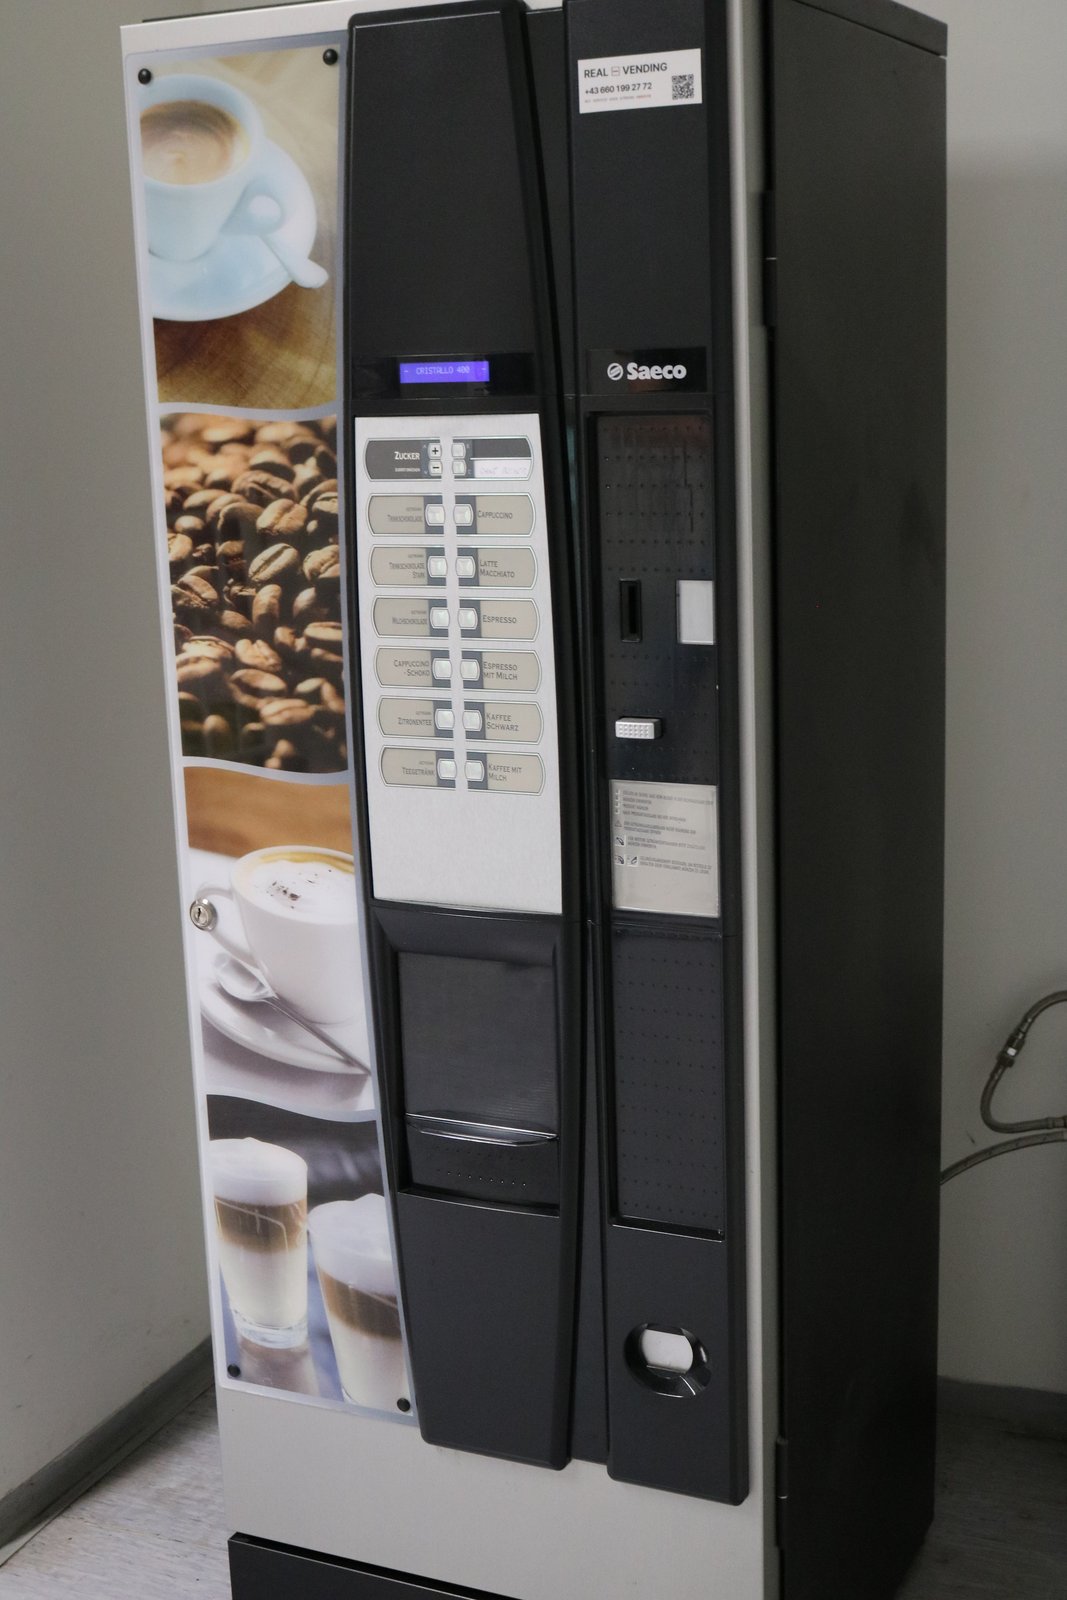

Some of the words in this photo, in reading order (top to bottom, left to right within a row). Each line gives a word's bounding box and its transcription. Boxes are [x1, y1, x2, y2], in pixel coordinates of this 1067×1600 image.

[584, 68, 609, 78] REAL
[622, 62, 668, 75] VENDING
[585, 87, 599, 95] +43
[600, 85, 615, 94] 660
[616, 84, 630, 92] 199
[632, 83, 640, 91] 27
[642, 82, 652, 90] 72
[626, 362, 687, 380] Saeco
[394, 451, 421, 460] ZUCKER
[478, 510, 513, 520] CAPPUCCINO
[480, 560, 498, 568] LATTE
[480, 568, 516, 578] MACCHIATO
[482, 614, 518, 624] ESPRESSO
[483, 661, 518, 672] ESPRESSO
[486, 712, 512, 722] KAFFEE
[486, 722, 519, 732] SCHWARZ
[488, 764, 510, 772] KAFFEE
